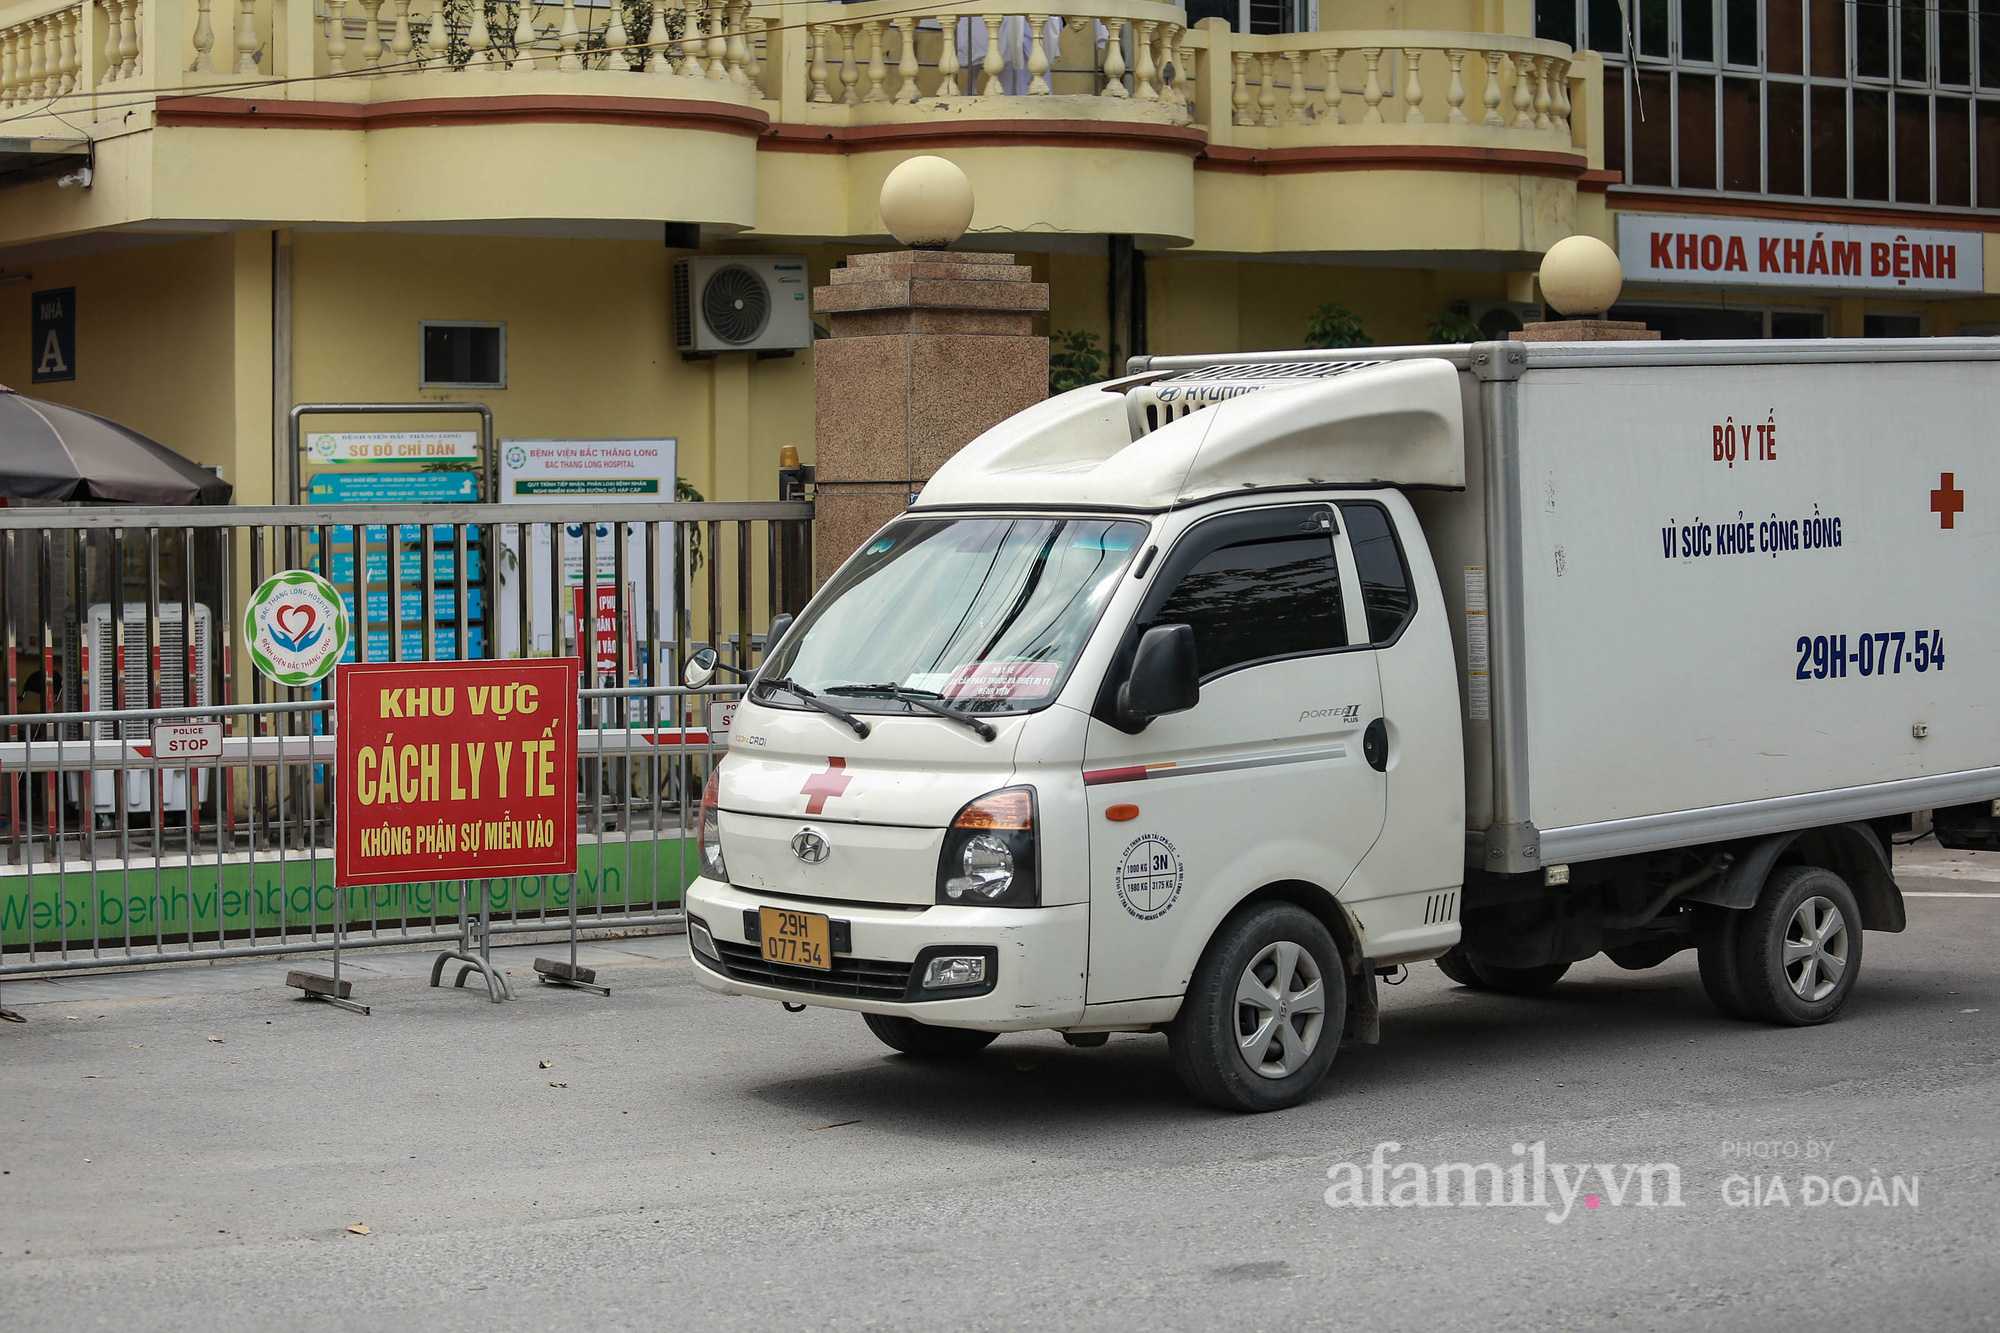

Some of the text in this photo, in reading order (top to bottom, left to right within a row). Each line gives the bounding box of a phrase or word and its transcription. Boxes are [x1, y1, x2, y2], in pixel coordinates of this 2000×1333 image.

[1650, 231, 1956, 286] KHOA KHÁM BỆNH
[41, 296, 63, 320] NHÀ
[37, 329, 67, 374] A
[349, 443, 370, 457] SƠ
[398, 440, 422, 456] CHỈ
[426, 439, 455, 455] DẪN
[1712, 407, 1777, 468] BỘ Y TẾ
[530, 444, 658, 459] BỆNH VIỆN BẮC THĂNG LONG
[545, 460, 635, 468] BAC THANG LONG HOSPITAL
[1662, 503, 1842, 559] VÌ SỨC KHỎE CỘNG ĐỒNG
[260, 606, 270, 620] BAC
[268, 590, 289, 607] THANG
[290, 588, 307, 596] LONG
[308, 591, 332, 619] HOSPITAL
[261, 638, 274, 656] BỆNH
[272, 654, 287, 668] VIỆN
[287, 660, 300, 670] BẮC
[301, 653, 321, 669] THĂNG
[319, 637, 331, 652] LONG
[380, 682, 539, 721] KHU VỰC
[173, 727, 204, 735] POLICE
[169, 739, 209, 752] STOP
[357, 718, 559, 806] CÁCH LY Y TẾ
[360, 810, 554, 860] KHÔNG PHẬN SỰ MIỄN VÀO
[1127, 863, 1148, 873] 1000 KG
[1153, 854, 1168, 871] 3N
[1127, 882, 1148, 892] 1980 KG
[1152, 879, 1173, 890] 3175 KG
[1, 892, 86, 931] Web:
[778, 912, 808, 938] 29H
[769, 936, 822, 965] 077.54
